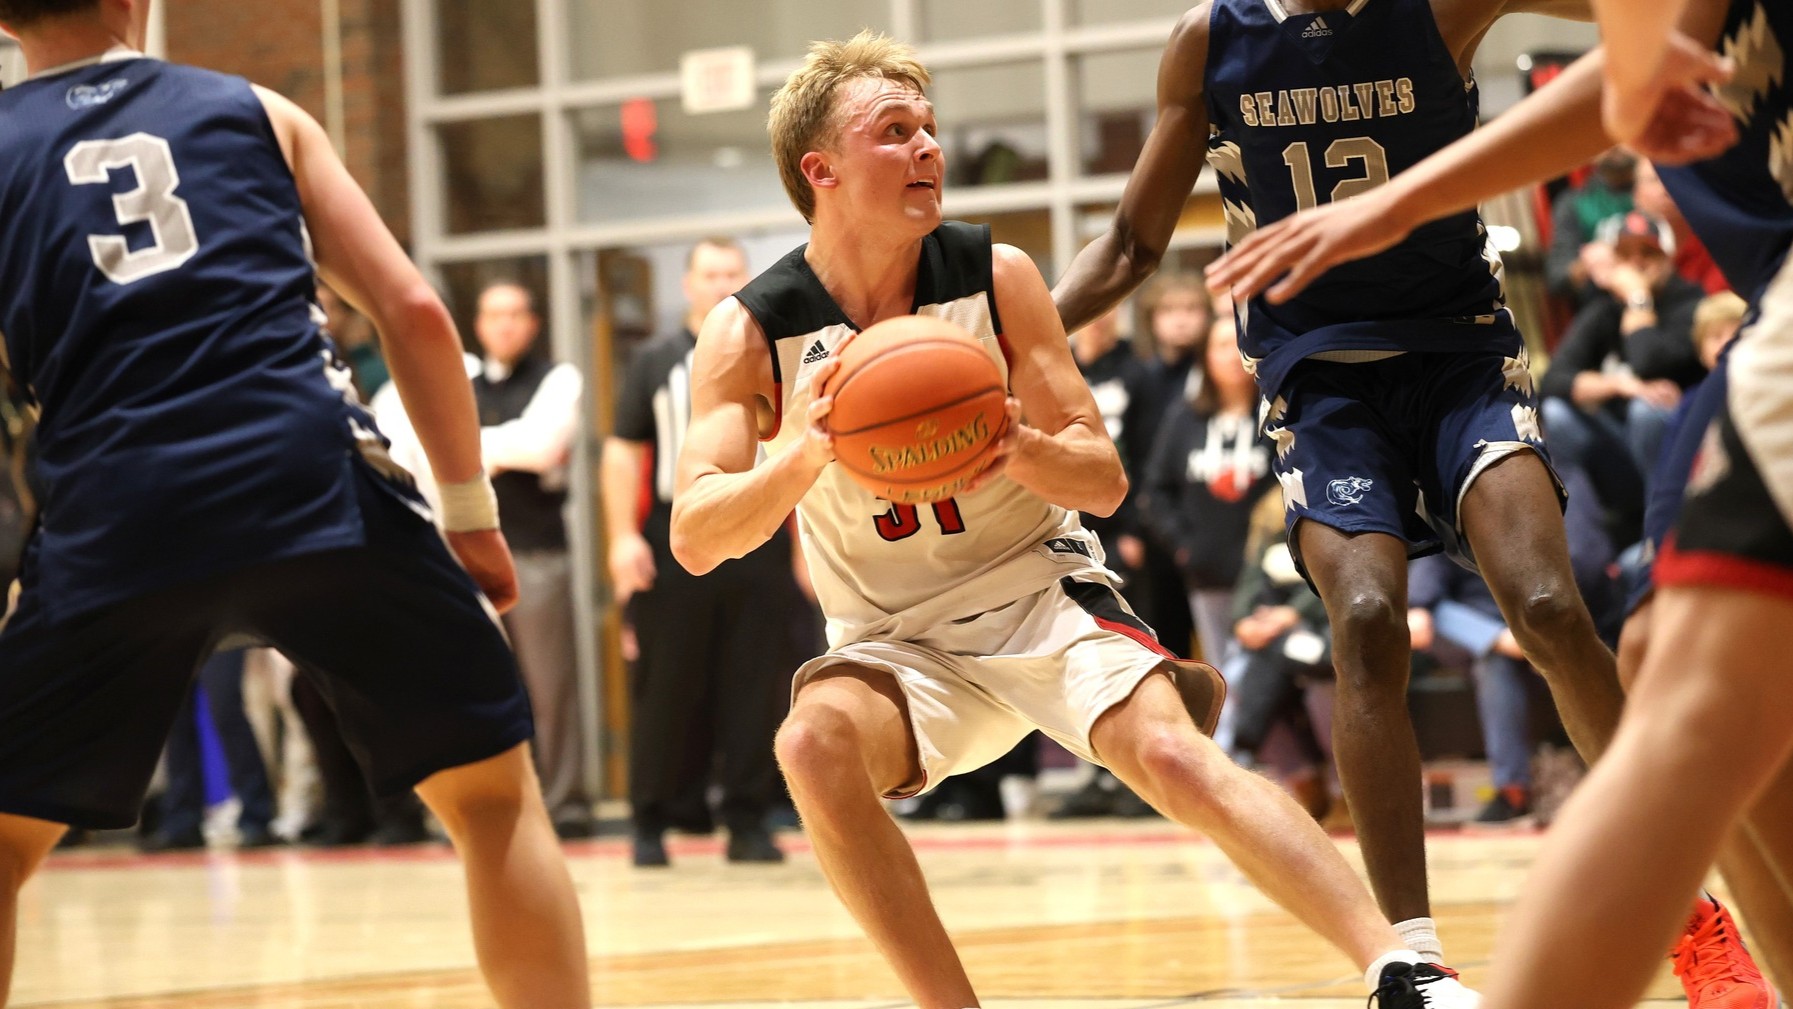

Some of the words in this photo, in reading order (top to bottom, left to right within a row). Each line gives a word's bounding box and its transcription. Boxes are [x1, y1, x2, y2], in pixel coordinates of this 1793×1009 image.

[1302, 28, 1333, 38] adidas
[1239, 77, 1416, 127] SEAWOLVES
[63, 131, 200, 285] 3
[1281, 136, 1391, 217] 12
[869, 411, 989, 474] SPALDING
